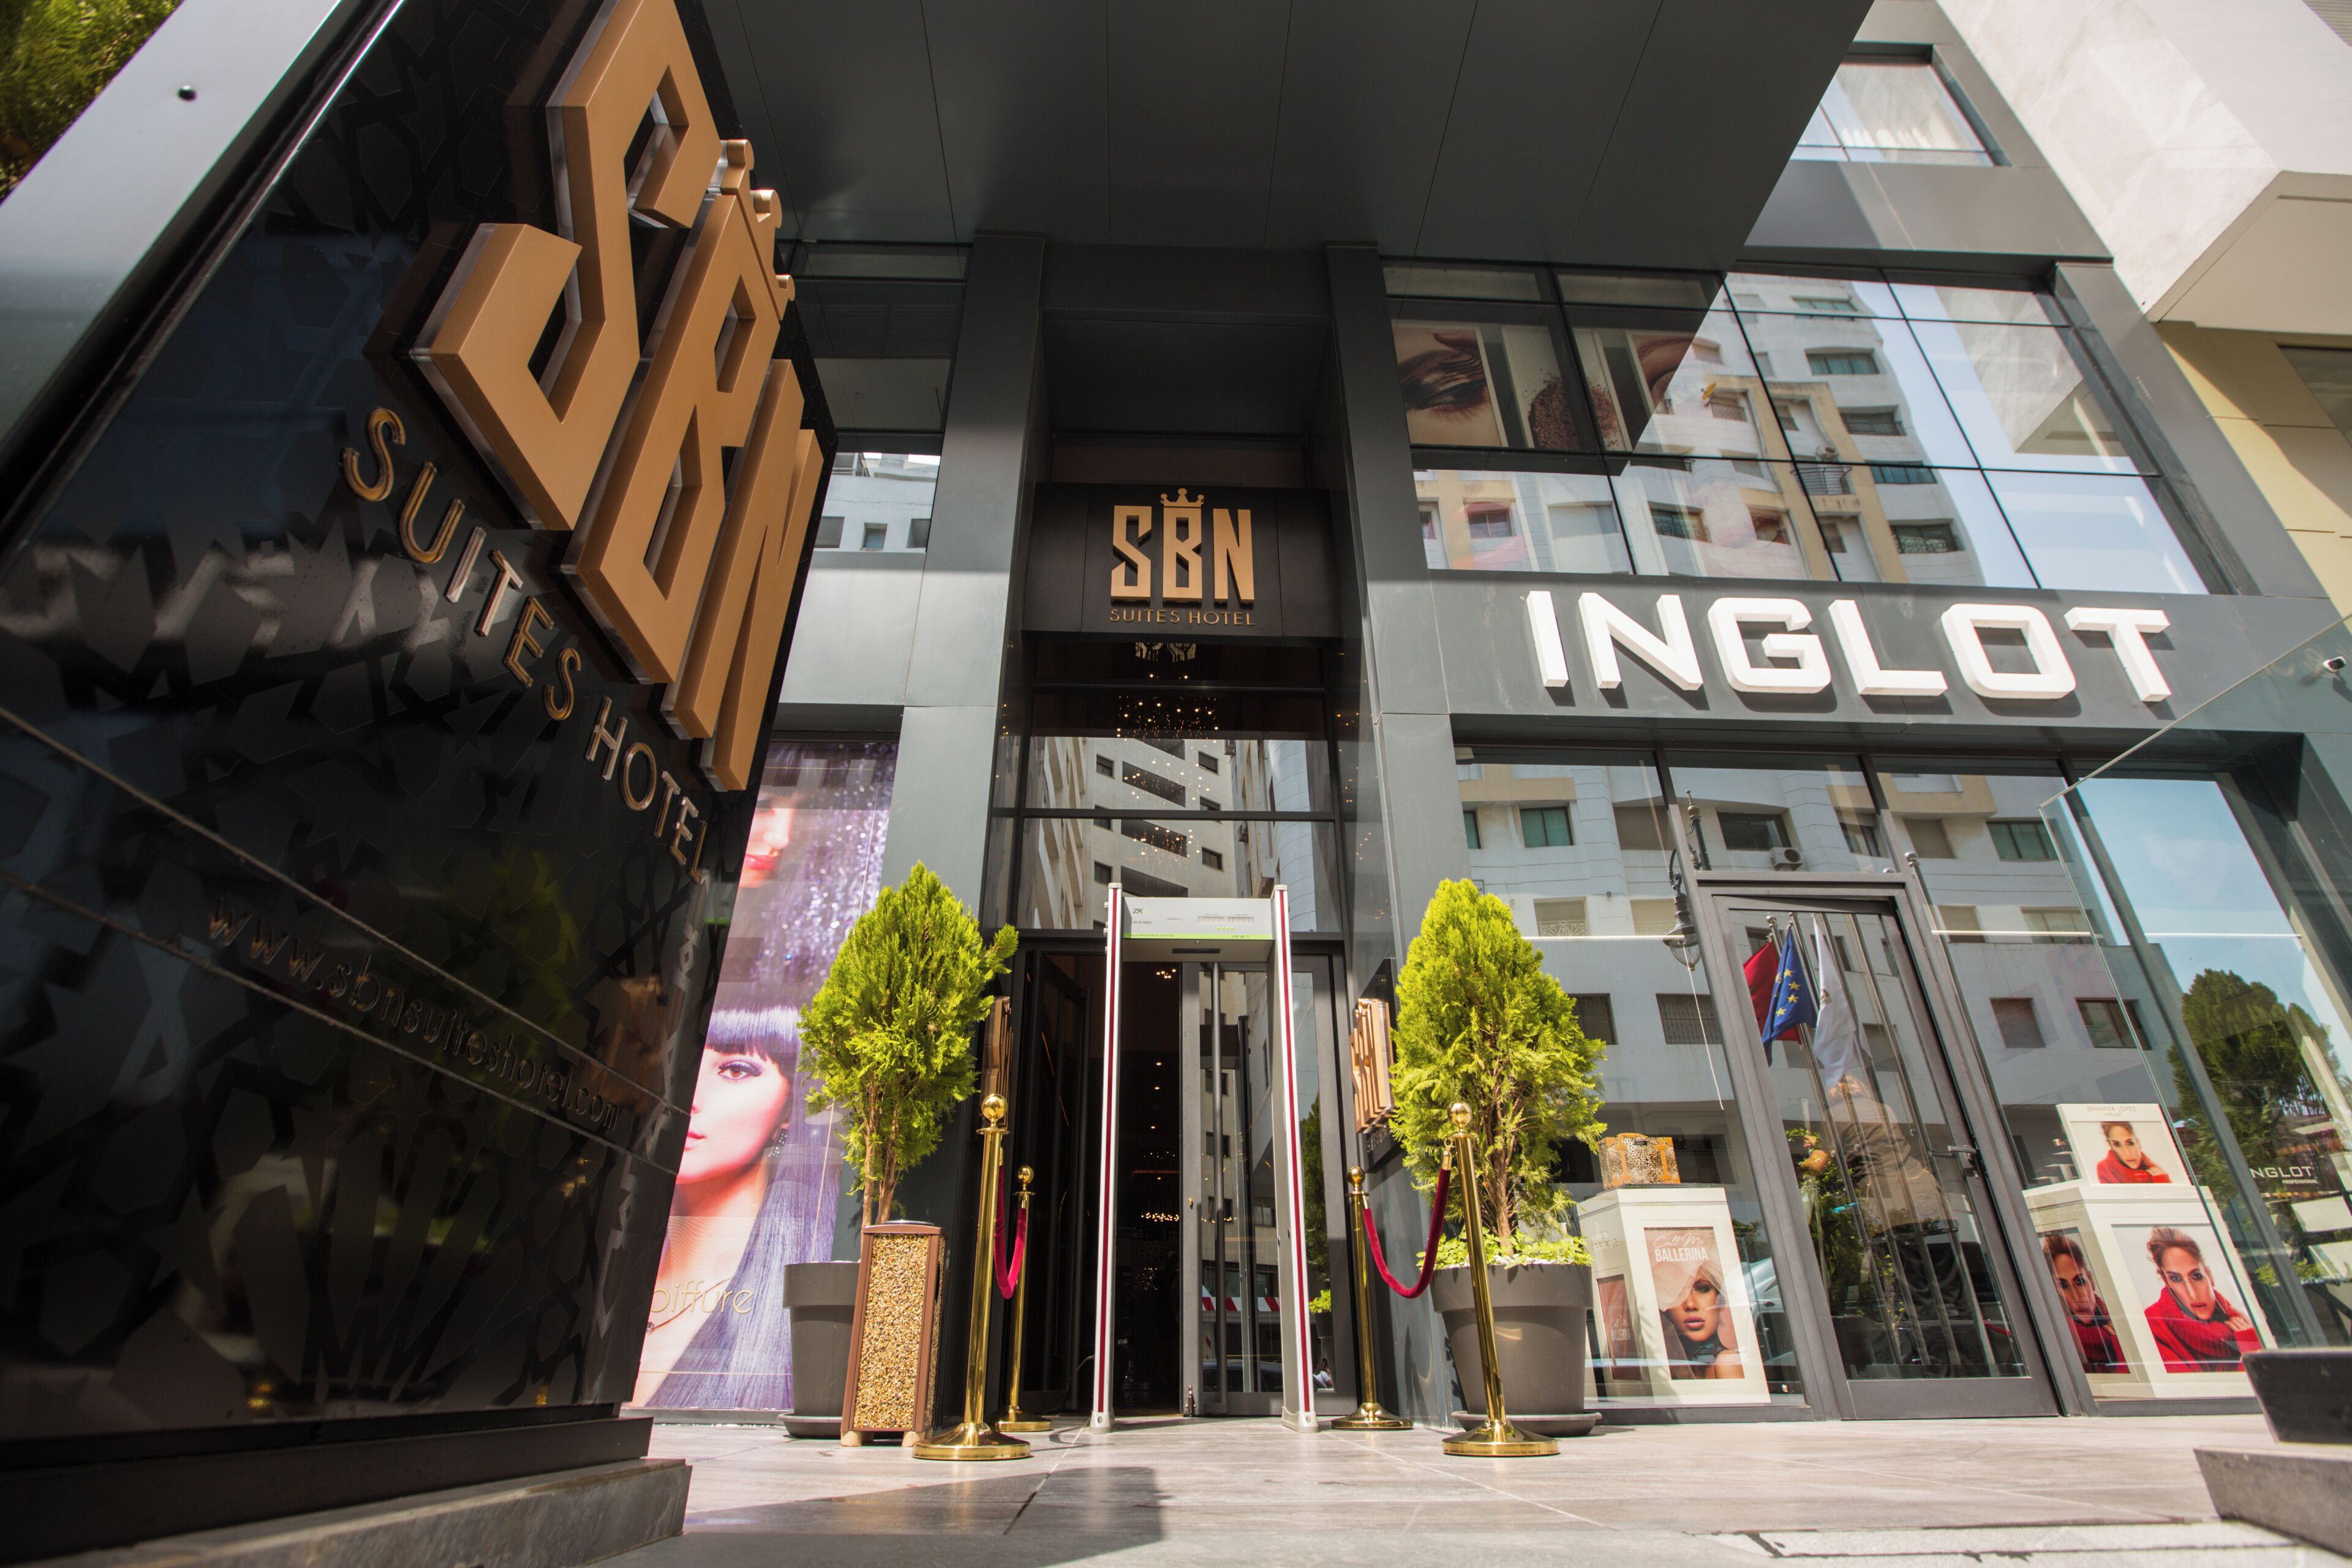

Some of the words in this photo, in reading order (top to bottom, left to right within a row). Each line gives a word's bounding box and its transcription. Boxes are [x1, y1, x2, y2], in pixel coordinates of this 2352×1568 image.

[410, 0, 824, 791] SBN
[1110, 505, 1255, 604] SBN
[341, 407, 582, 722] SUITES
[584, 695, 709, 886] HOTEL
[1109, 608, 1180, 624] SUITES
[1188, 610, 1255, 627] HOTEL
[1525, 590, 2172, 703] INGLOT
[208, 895, 620, 1131] www.sbnsuiteshotel.com
[2248, 1166, 2312, 1178] NGLOT
[1653, 1235, 1681, 1248] Call
[1681, 1232, 1706, 1248] Me
[1654, 1247, 1709, 1262] BALLERINA
[650, 1278, 754, 1314] oiffure
